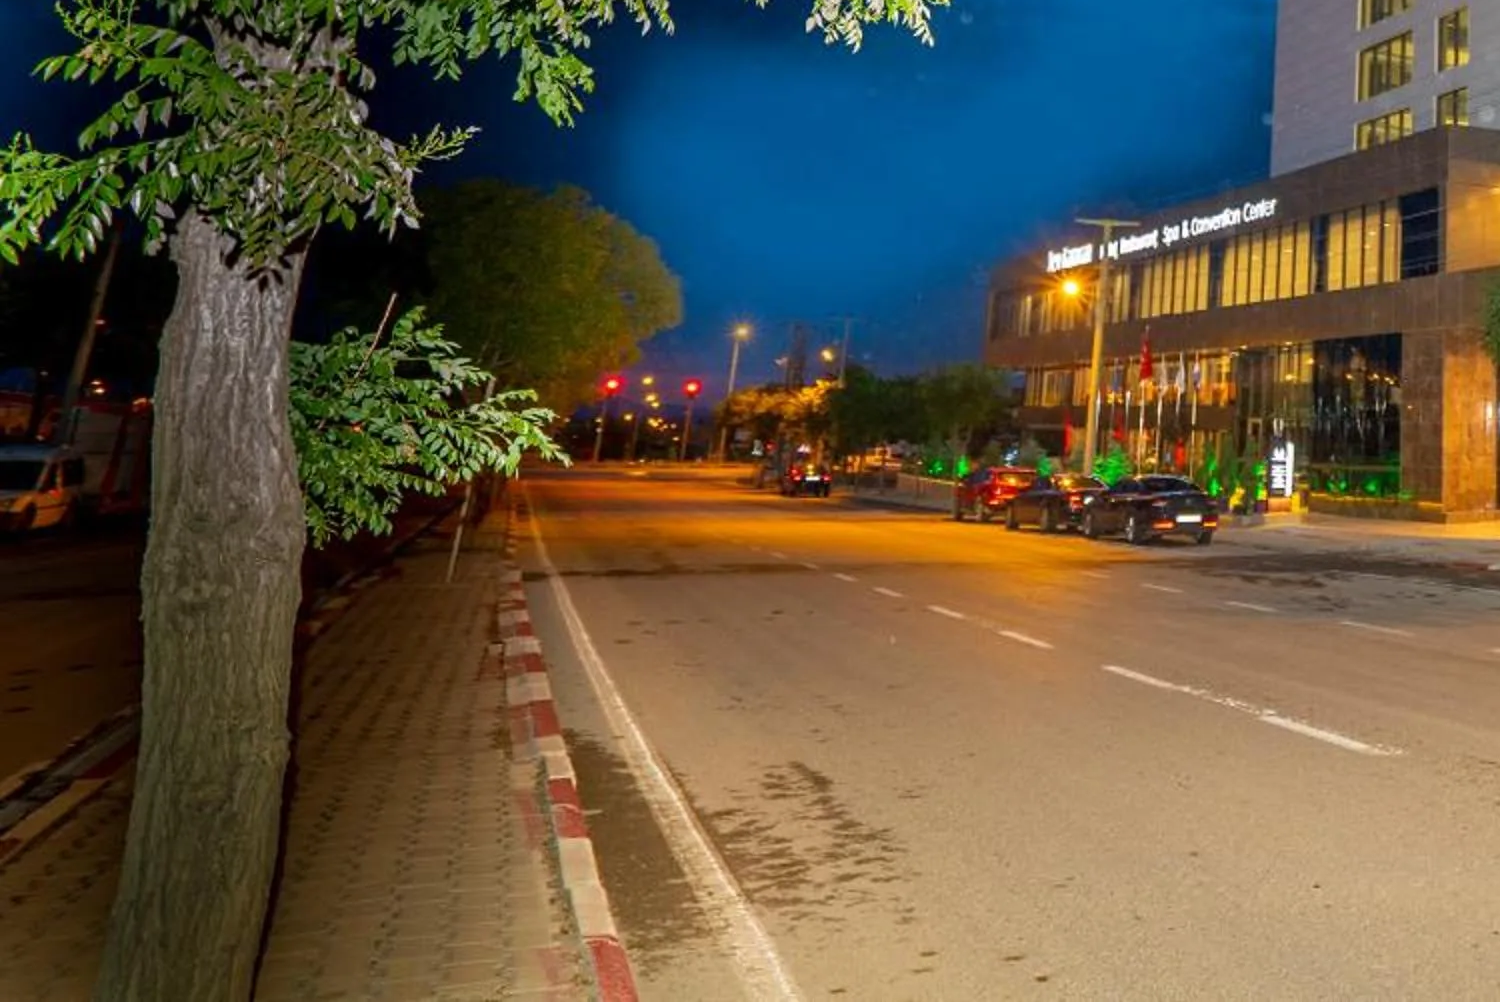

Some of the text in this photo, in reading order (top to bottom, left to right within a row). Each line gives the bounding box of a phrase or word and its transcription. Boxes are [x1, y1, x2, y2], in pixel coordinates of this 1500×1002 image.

[1161, 224, 1180, 247] Spa
[1181, 219, 1190, 239] &
[1190, 207, 1241, 237] Convention
[1243, 198, 1278, 223] Center
